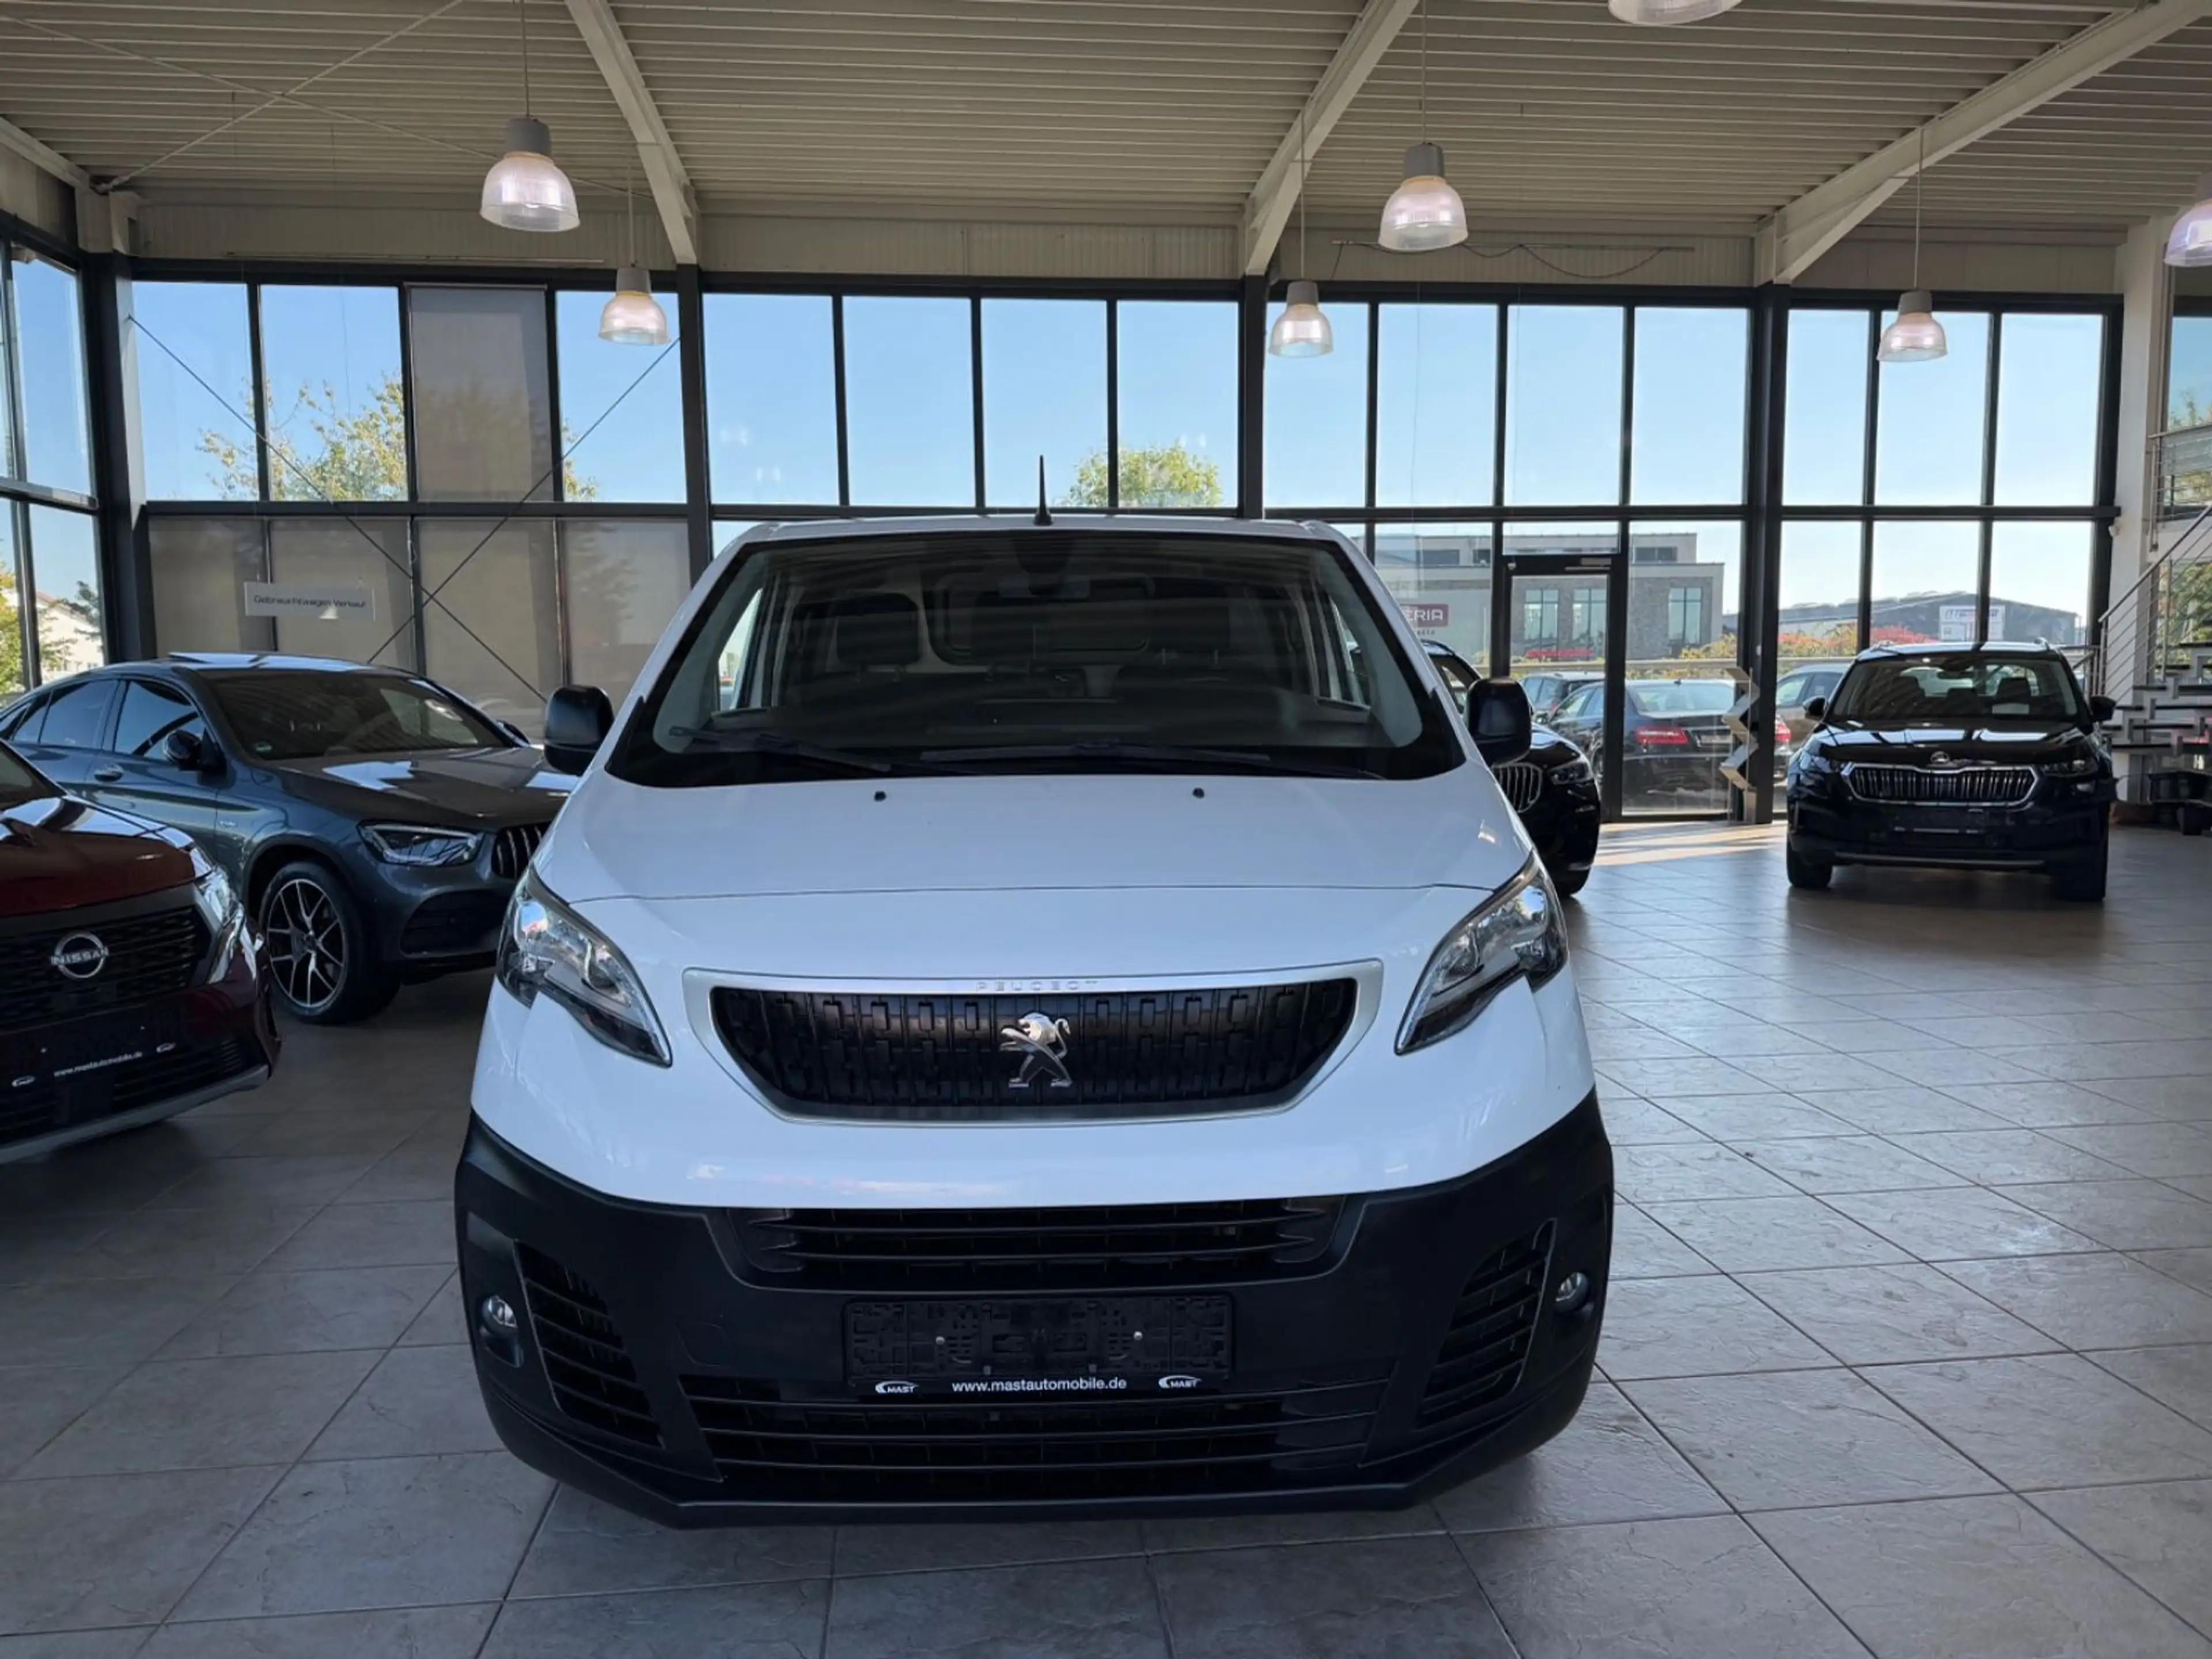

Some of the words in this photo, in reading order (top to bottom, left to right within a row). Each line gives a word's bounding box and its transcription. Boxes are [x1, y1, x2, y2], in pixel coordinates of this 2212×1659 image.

[51, 946, 109, 965] NISSAN
[976, 980, 1099, 992] PEUGEOT
[887, 1385, 915, 1393] MAST
[952, 1376, 1127, 1392] www.mastautomobile.de
